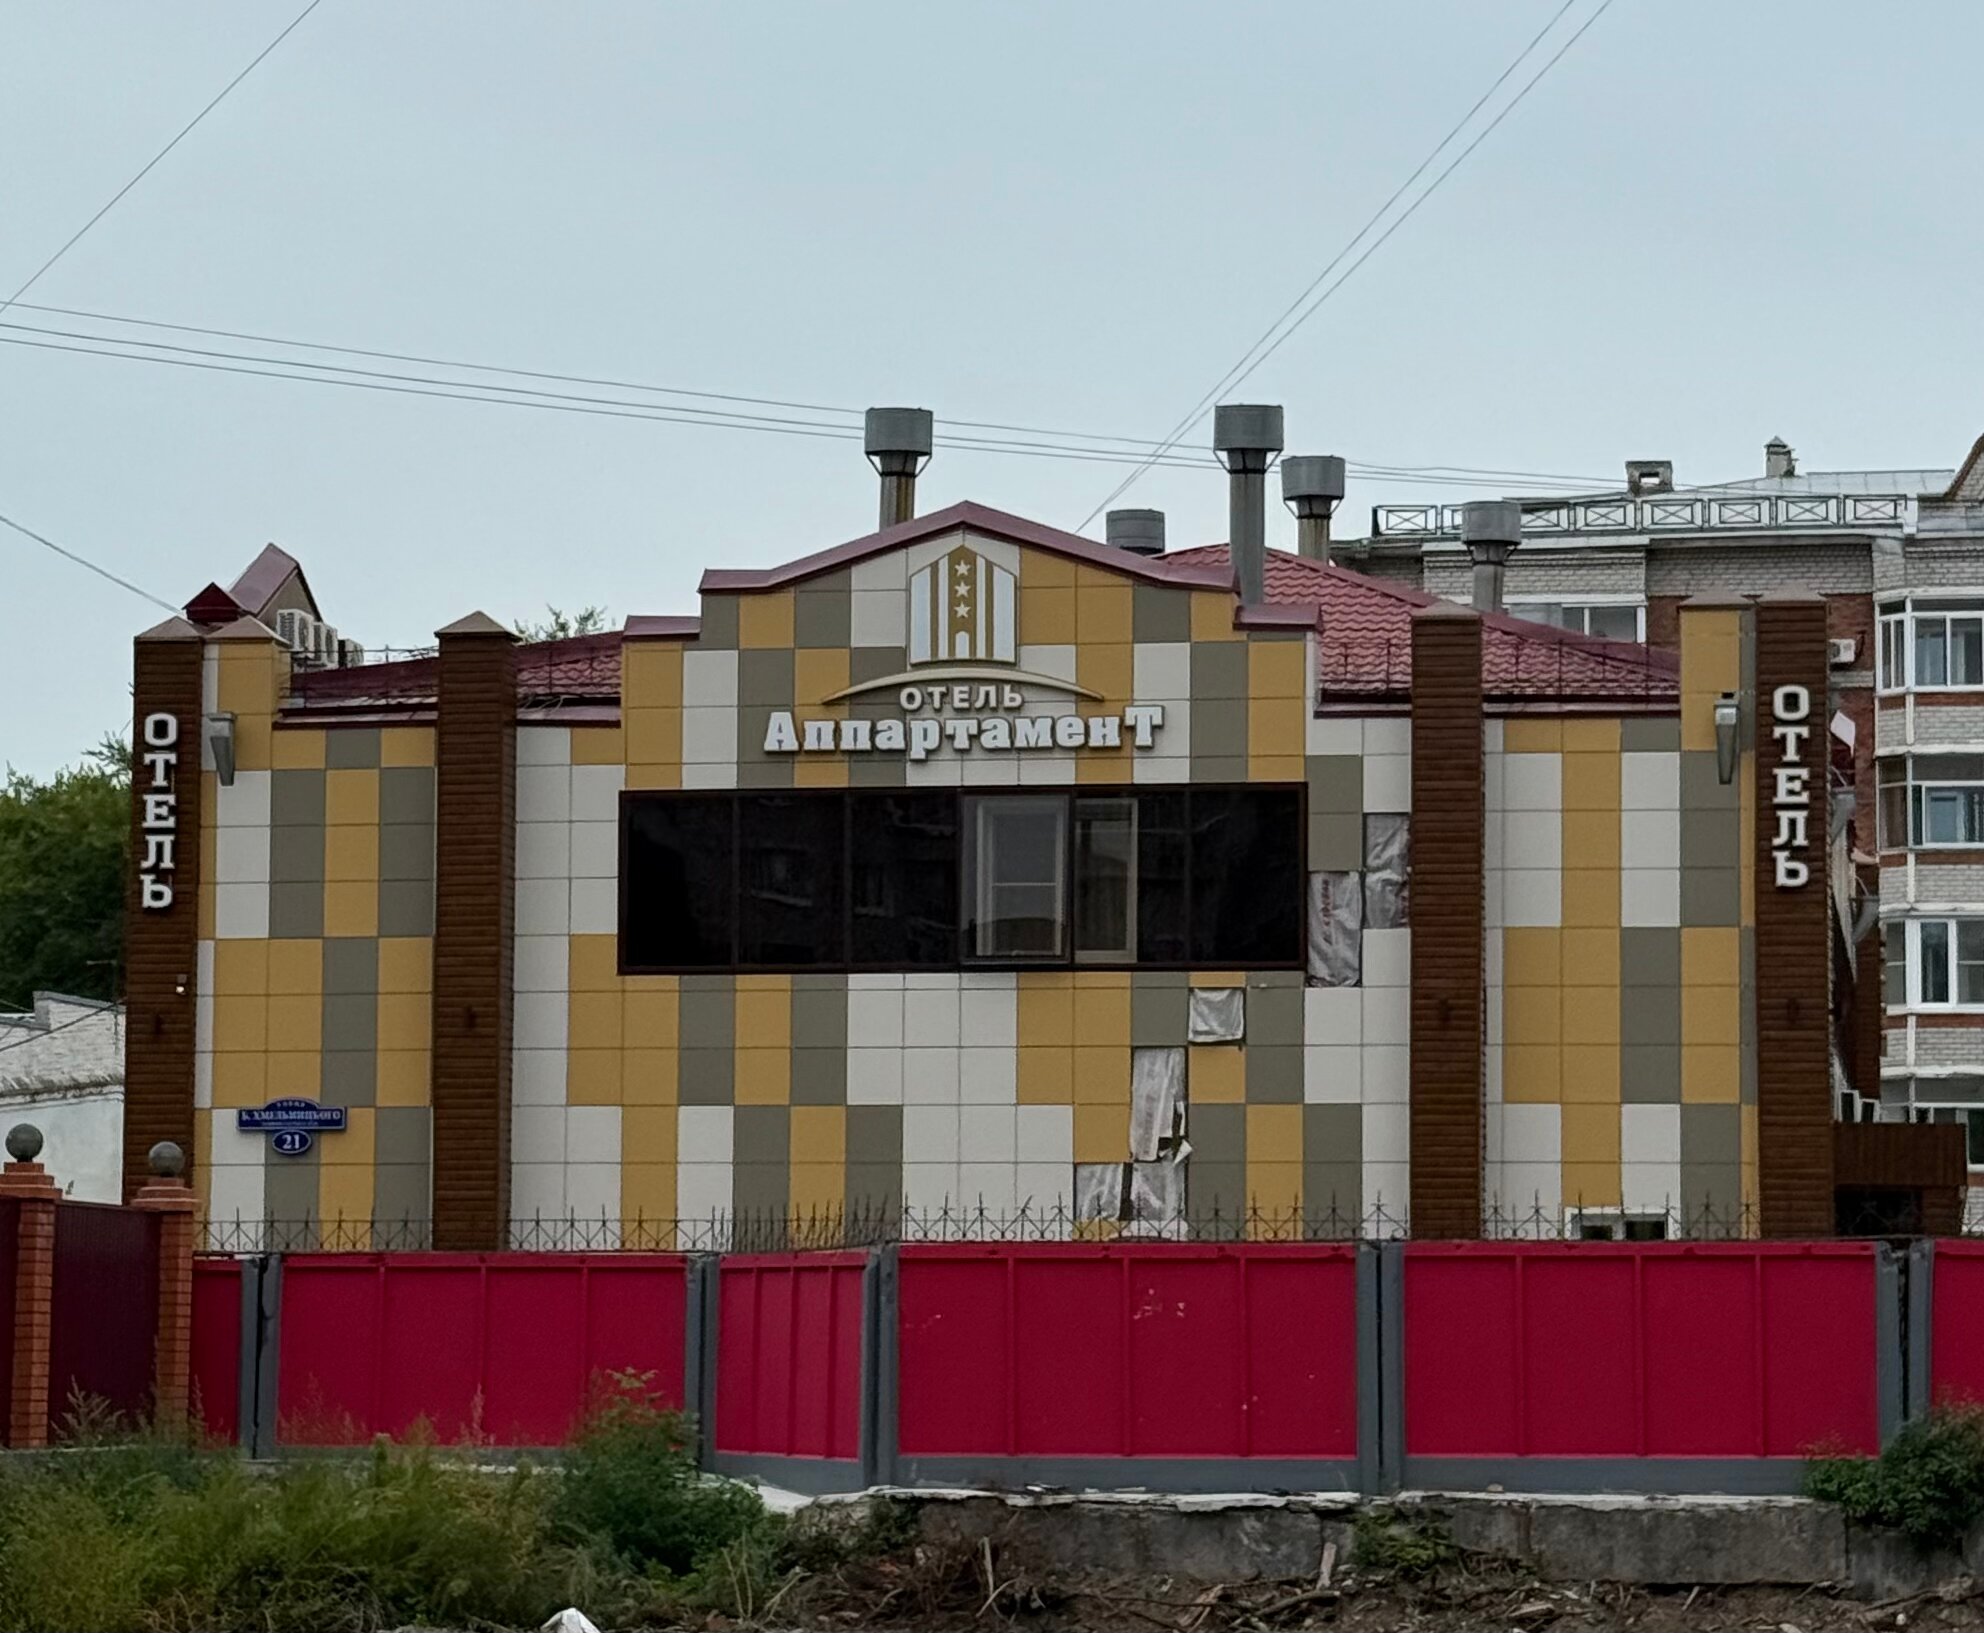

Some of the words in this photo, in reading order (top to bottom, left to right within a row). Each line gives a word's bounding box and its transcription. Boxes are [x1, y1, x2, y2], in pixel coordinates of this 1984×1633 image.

[899, 685, 1023, 710] ОТЕЛЬ
[140, 713, 178, 908] ОТЕЛЬ
[1772, 685, 1810, 887] ОТЕЛЬ
[282, 1134, 300, 1149] 21
